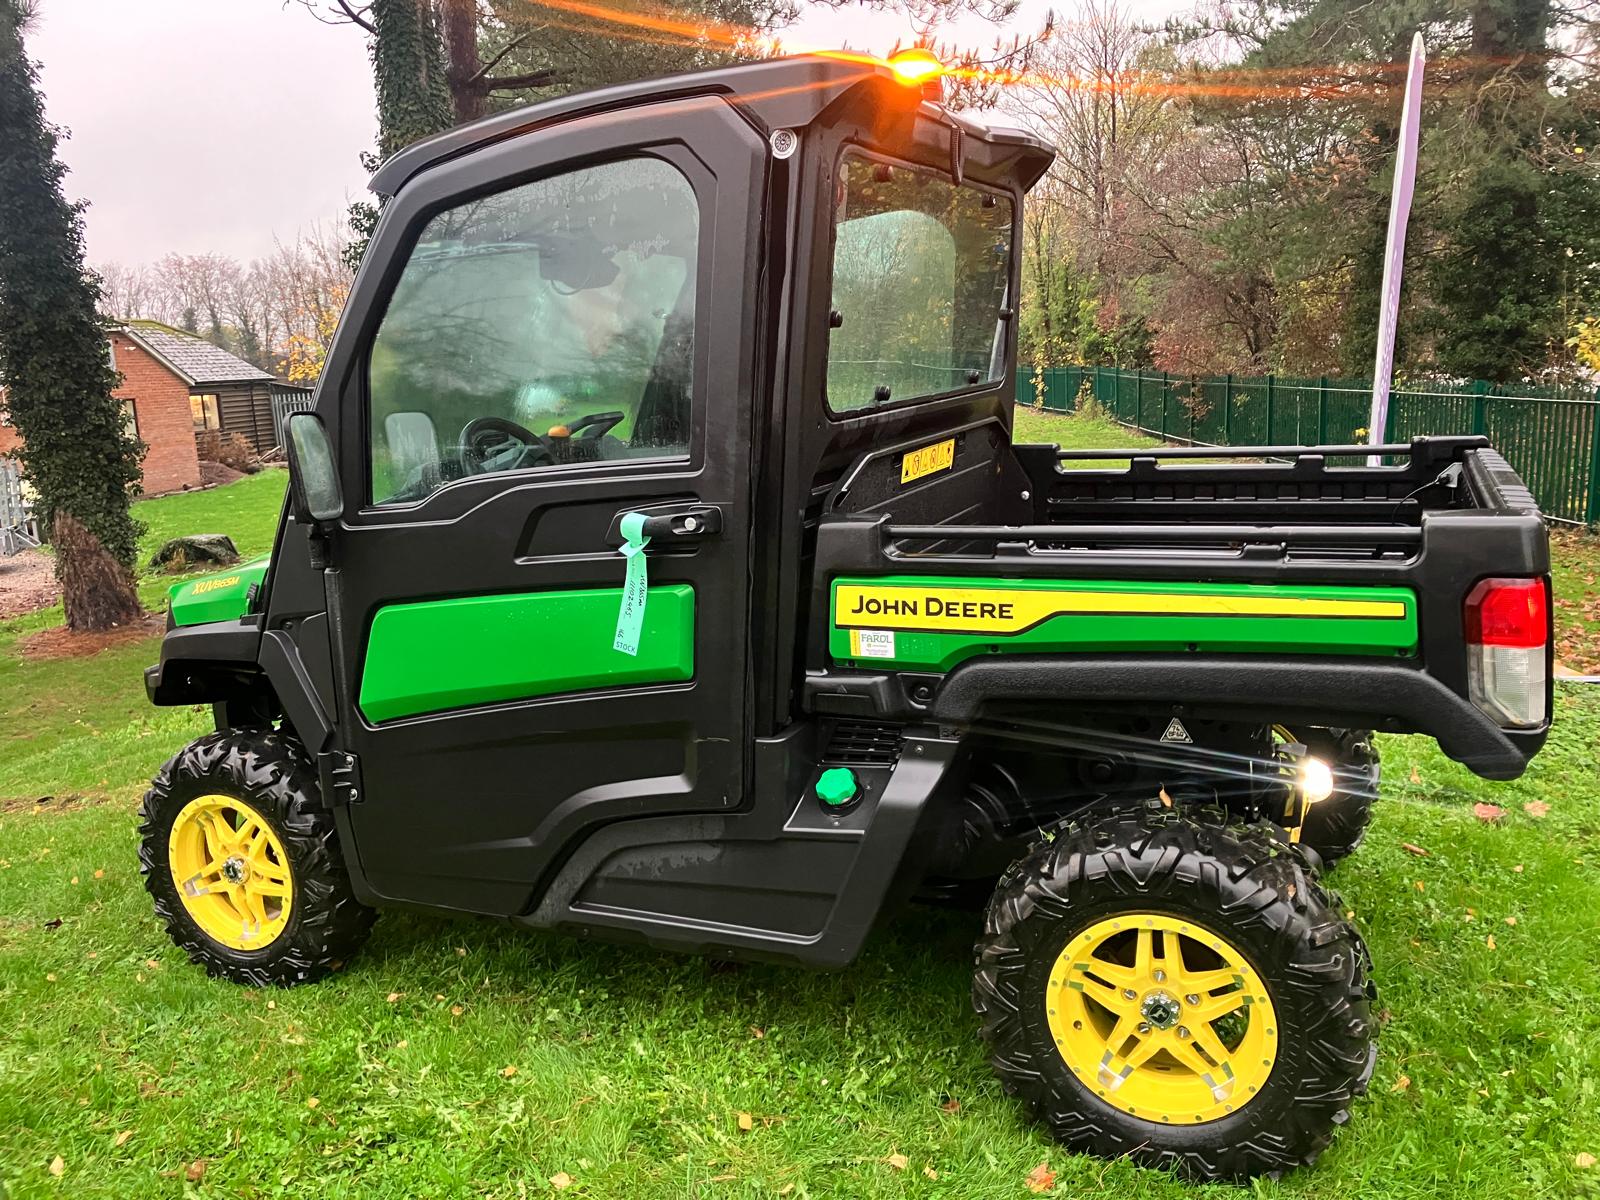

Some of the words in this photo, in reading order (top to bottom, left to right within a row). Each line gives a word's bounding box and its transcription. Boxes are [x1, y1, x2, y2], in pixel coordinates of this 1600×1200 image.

[851, 595, 918, 616] JOHN
[925, 597, 1014, 620] DEERE
[861, 633, 893, 644] FAROL
[615, 641, 636, 653] STOCK
